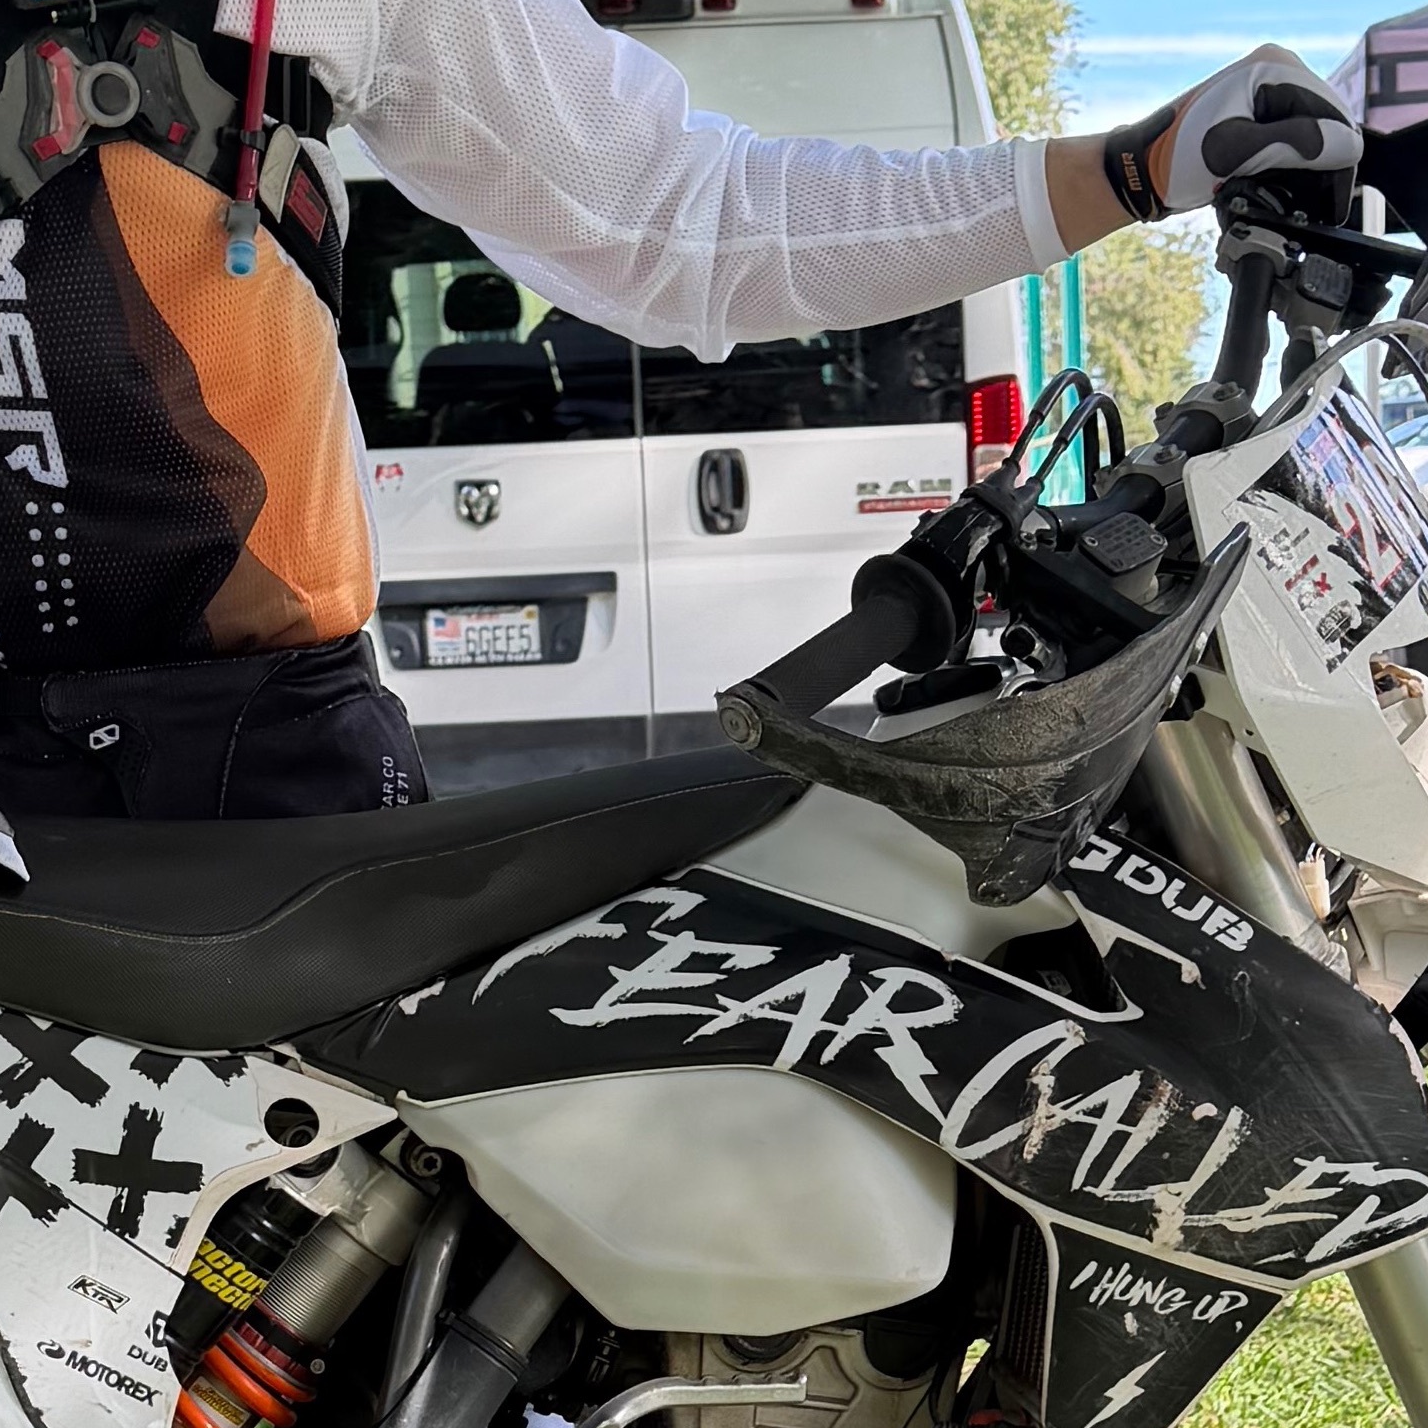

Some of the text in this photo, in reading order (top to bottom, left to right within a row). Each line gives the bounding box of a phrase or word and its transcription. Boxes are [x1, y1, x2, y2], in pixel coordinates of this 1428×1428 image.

[473, 885, 965, 1123] FEAR
[1089, 1262, 1192, 1315] HUNG
[65, 1350, 160, 1408] MOTOREX
[127, 1344, 169, 1373] DUB
